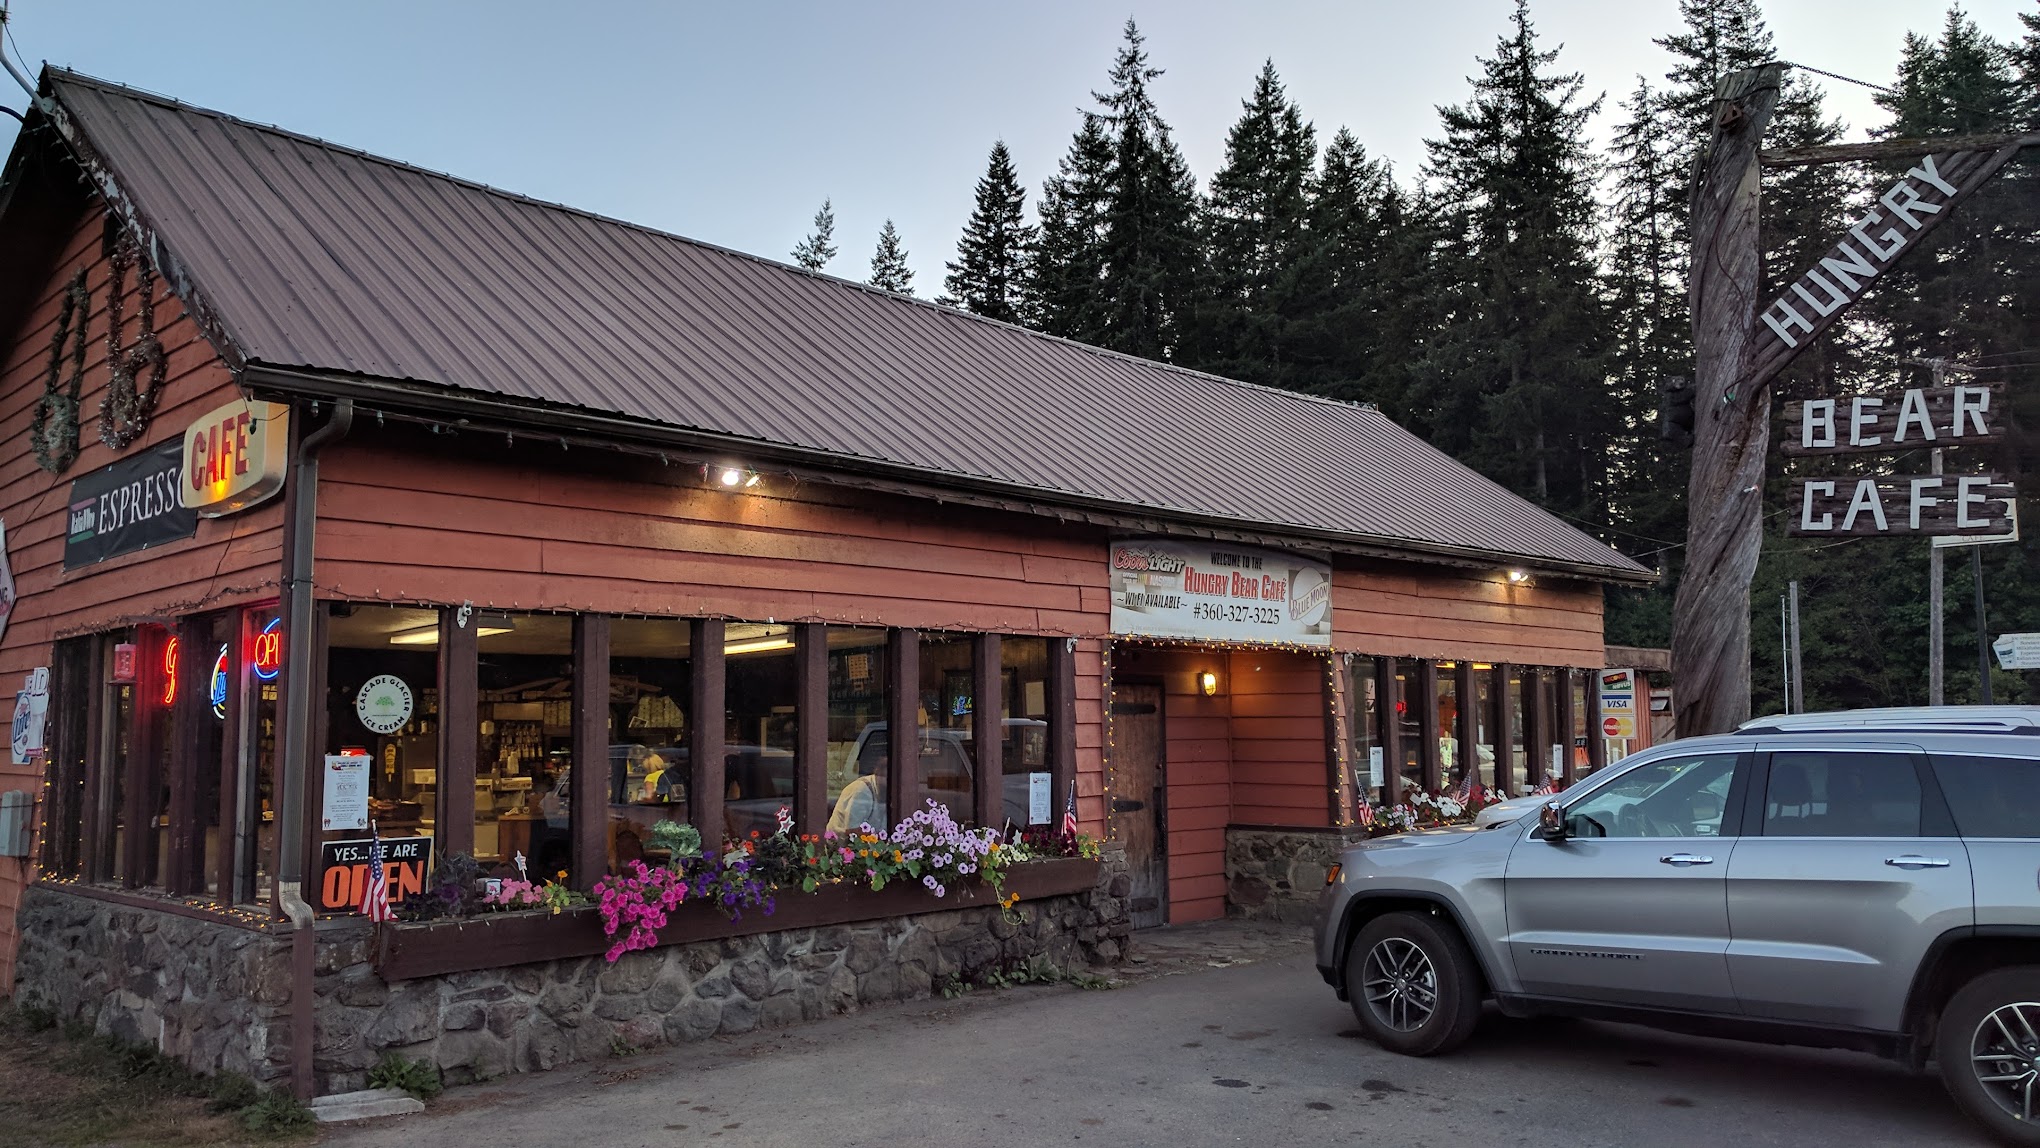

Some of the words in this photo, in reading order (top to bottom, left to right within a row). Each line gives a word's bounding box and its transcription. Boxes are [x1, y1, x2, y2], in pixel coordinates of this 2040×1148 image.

[1760, 154, 1958, 349] HUNGRY
[1802, 385, 1990, 448] BEAR
[191, 411, 251, 491] CAFE
[1801, 477, 1991, 531] CAFE
[1147, 555, 1185, 574] LIGHT
[1211, 552, 1240, 568] WELCOME
[1242, 556, 1250, 569] TO
[1251, 556, 1262, 570] THE
[1184, 567, 1229, 597] HUNGRY
[1231, 572, 1259, 600] BEAR
[1193, 602, 1280, 625] #360-327-3225
[1290, 595, 1310, 621] BLUE
[1310, 585, 1329, 607] MOON
[255, 633, 280, 666] OP
[360, 678, 386, 711] CASCADE
[390, 679, 410, 712] GLACIER
[363, 716, 376, 728] ICE
[378, 716, 405, 731] CREAM
[393, 844, 419, 858] ARE
